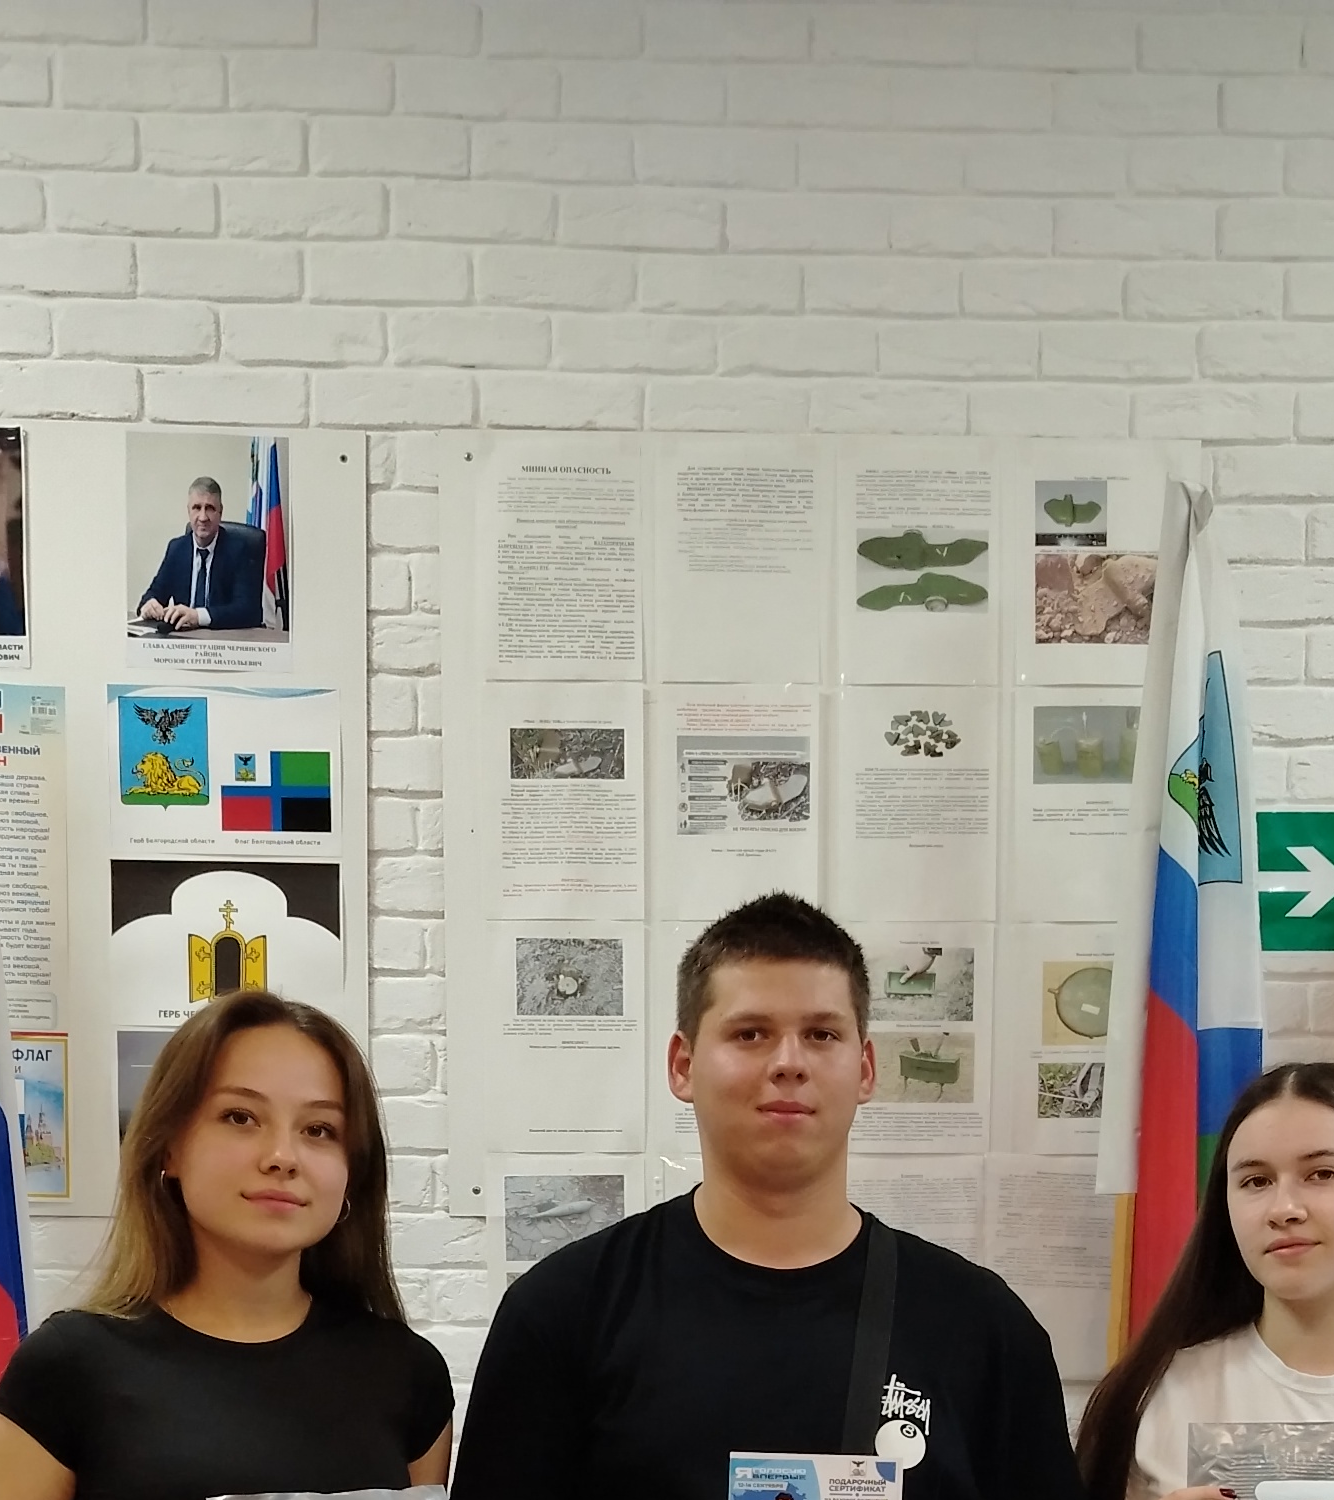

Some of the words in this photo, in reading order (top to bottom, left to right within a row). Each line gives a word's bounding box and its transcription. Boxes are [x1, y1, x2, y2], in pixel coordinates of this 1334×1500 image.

[521, 465, 558, 473] МИННАЯ
[560, 466, 611, 475] ОПАСНОСТЬ
[158, 1009, 181, 1019] ГЕРБ
[12, 1049, 53, 1062] ФЛАГ
[902, 1424, 915, 1437] 8
[735, 1467, 753, 1479] Я
[828, 1477, 887, 1486] ПОДАРОЧНЫЙ
[828, 1485, 886, 1493] СЕРТИФИКАТ
